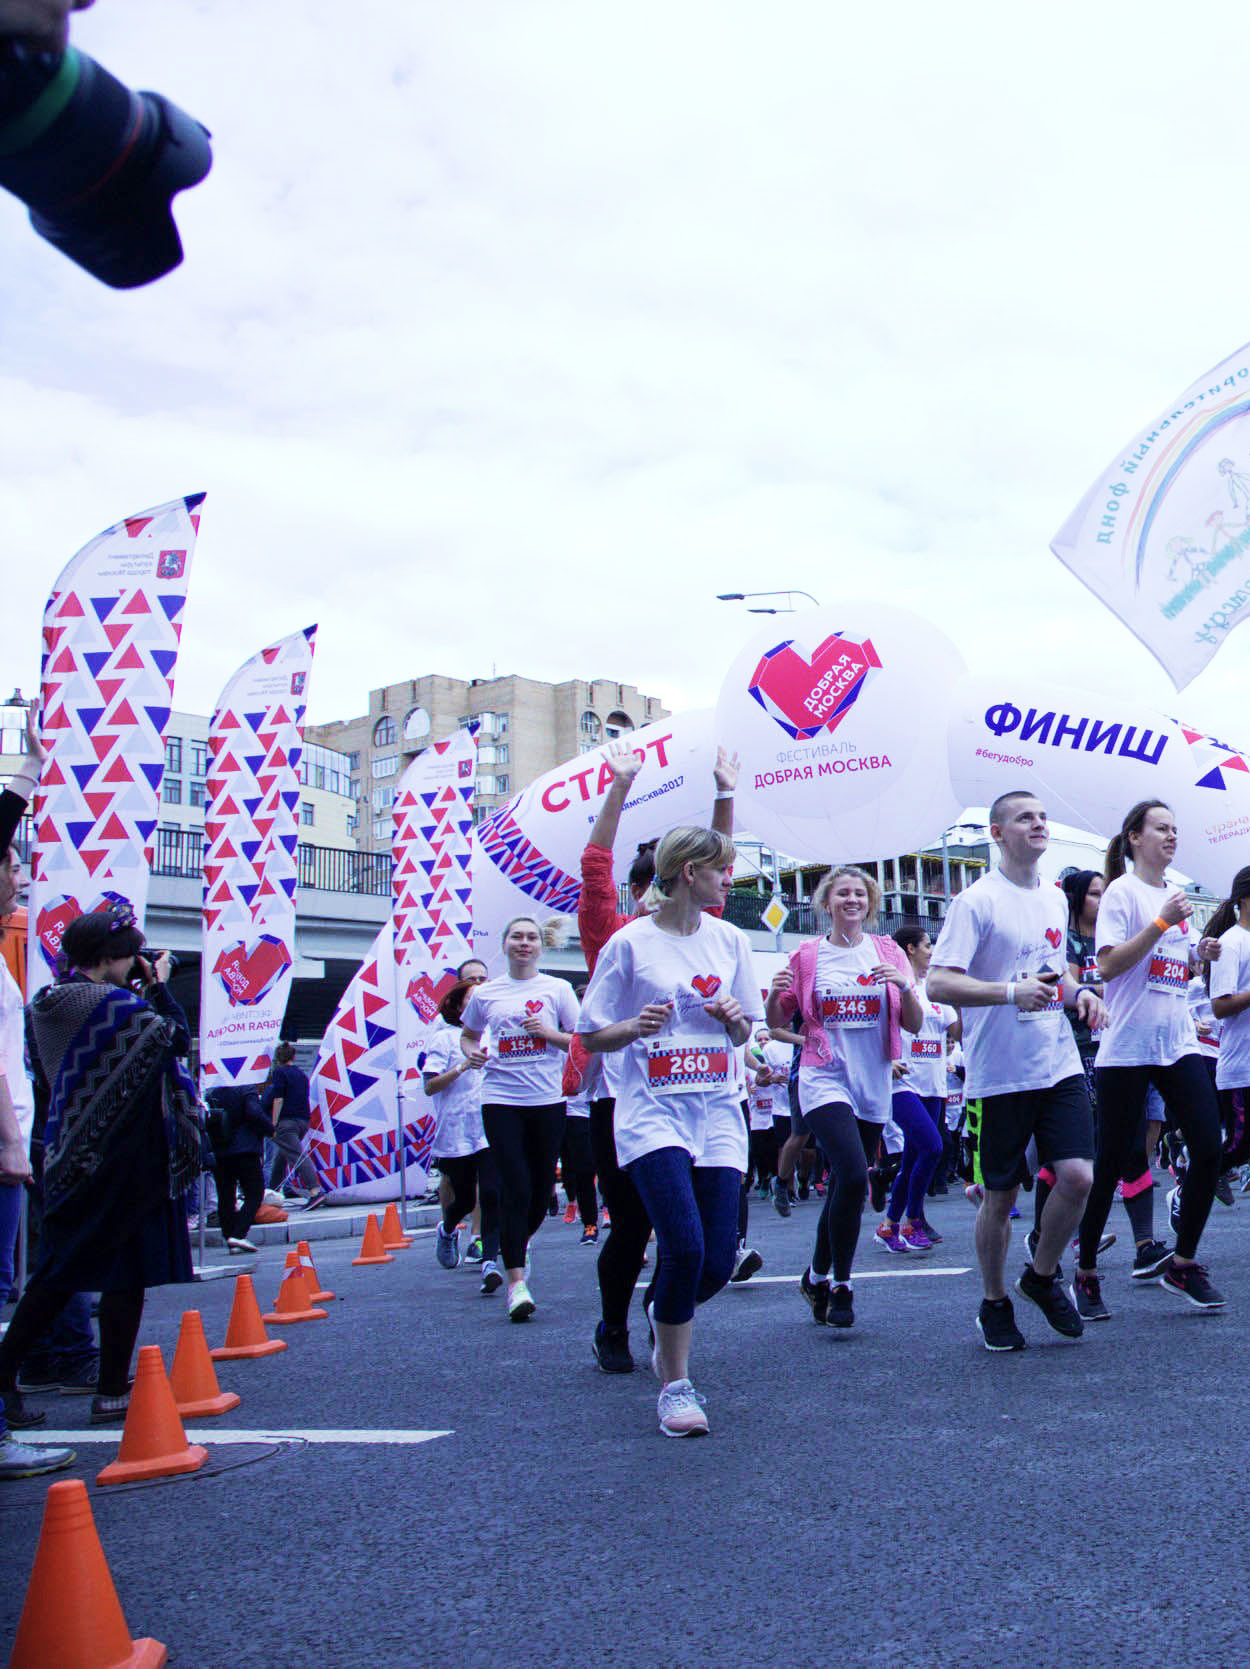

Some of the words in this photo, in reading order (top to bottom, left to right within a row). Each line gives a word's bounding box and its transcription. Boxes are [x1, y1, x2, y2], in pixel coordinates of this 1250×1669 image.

[804, 653, 852, 712] ДОБРАЯ
[814, 662, 864, 719] МОСКВА
[984, 702, 1169, 765] ФИНИШ
[776, 742, 857, 763] ФЕСТИВАЛЬ
[975, 748, 1034, 767] #бегудобро
[754, 766, 813, 790] ДОБРАЯ
[818, 755, 892, 776] МОСКВА
[587, 775, 684, 824] #ямосква2017
[1164, 962, 1185, 979] 204
[838, 1000, 867, 1014] 346
[511, 1039, 535, 1051] 154
[922, 1043, 937, 1053] 360
[670, 1055, 710, 1073] 260
